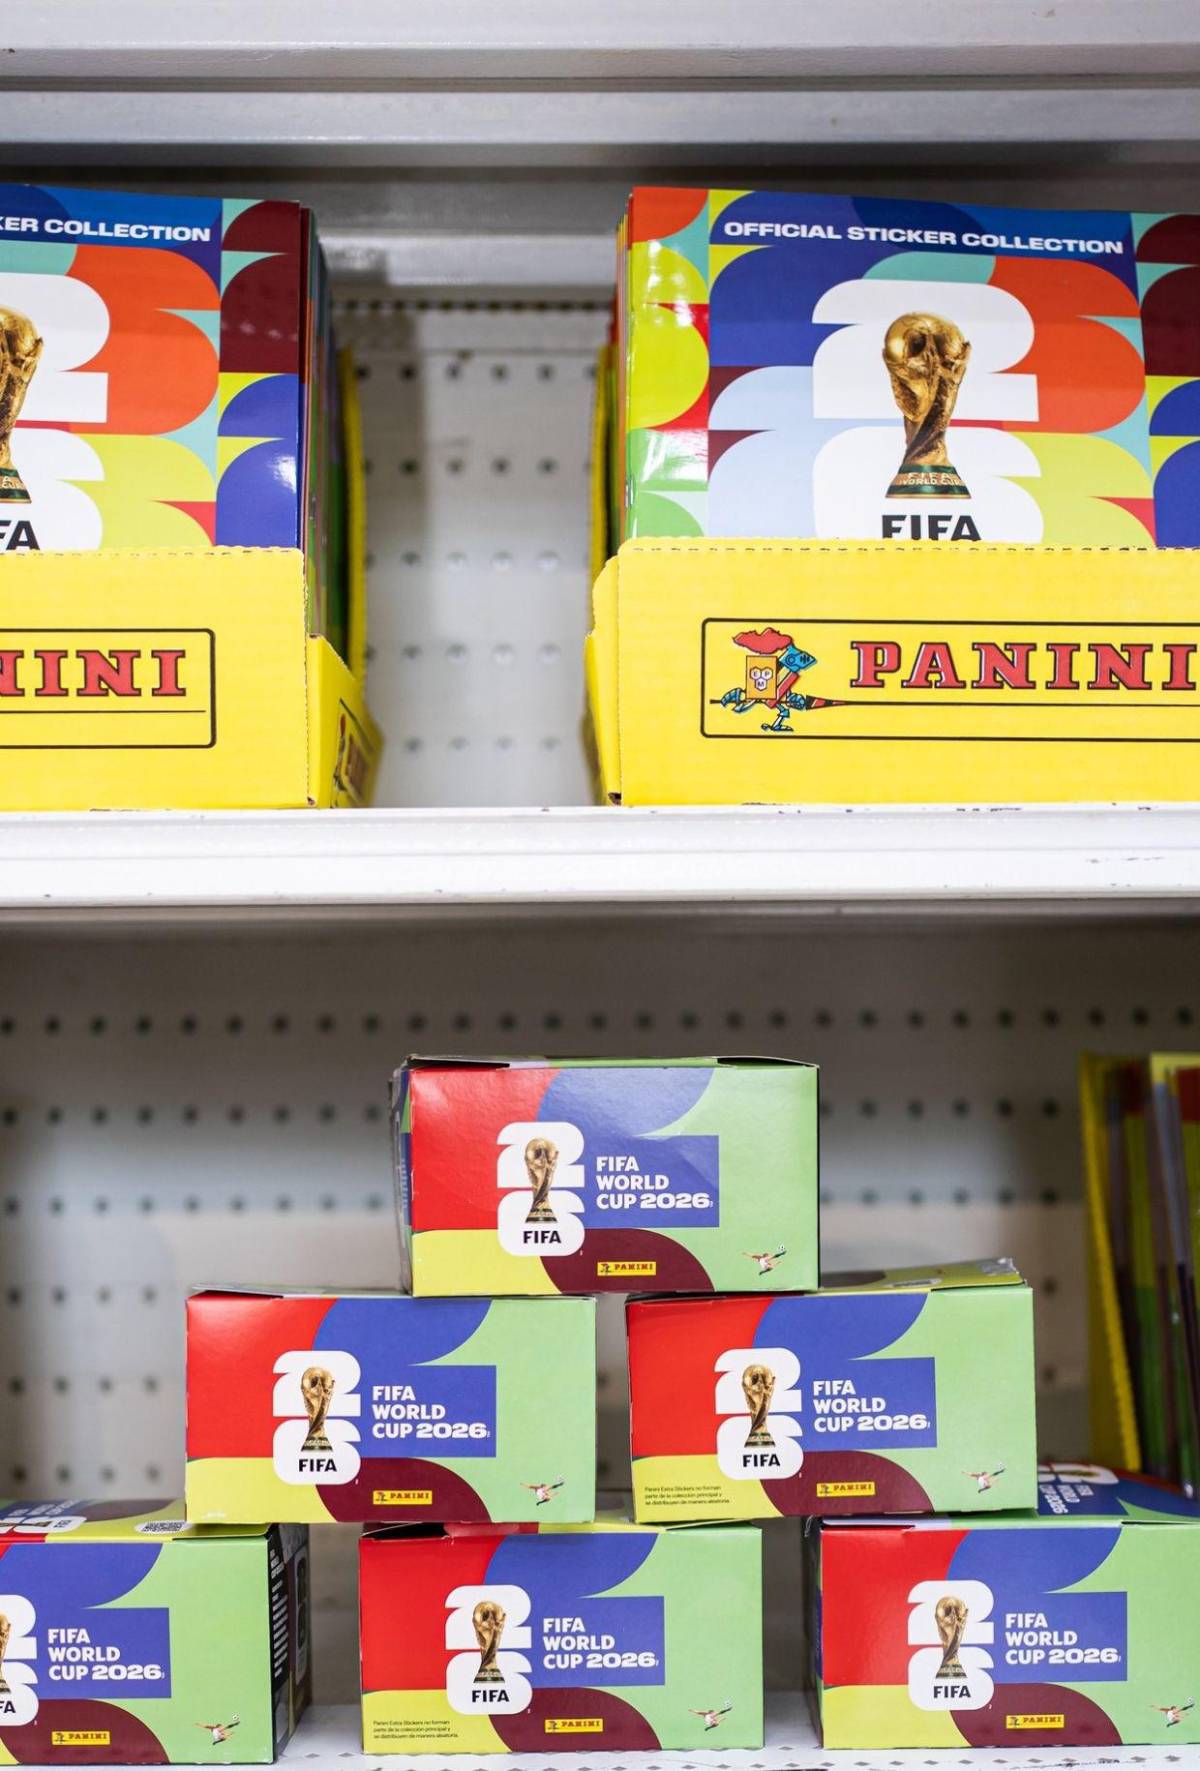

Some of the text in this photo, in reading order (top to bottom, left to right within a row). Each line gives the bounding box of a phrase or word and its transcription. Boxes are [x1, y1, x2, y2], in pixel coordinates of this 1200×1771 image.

[44, 219, 211, 242] COLLECTION
[724, 222, 1123, 254] OFFICIAL STICKER COLLECTION
[882, 514, 982, 541] FIFA
[850, 641, 1197, 691] PANINI
[597, 1155, 640, 1172] FIFA
[596, 1174, 670, 1191] WORLD
[596, 1192, 710, 1210] CUP 2026
[523, 1230, 561, 1244] FIFA
[614, 1263, 653, 1271] PANINI
[372, 1385, 416, 1401] FIFA
[813, 1379, 856, 1396] FIFA
[372, 1403, 446, 1420] WORLD
[813, 1397, 887, 1414] WORLD
[372, 1422, 487, 1439] CUP 2026
[814, 1414, 927, 1433] CUP 2026
[298, 1458, 337, 1472] FIFA
[742, 1453, 781, 1468] FIFA
[833, 1483, 872, 1491] PANINI
[543, 1617, 586, 1633] FIFA
[1005, 1612, 1048, 1629] FIFA
[47, 1628, 91, 1644] FIFA
[543, 1634, 616, 1651] WORLD
[1005, 1630, 1078, 1647] WORLD
[47, 1646, 121, 1663] WORLD
[543, 1651, 656, 1670] CUP 2026
[1005, 1647, 1119, 1665] CUP 2026
[48, 1664, 162, 1681] CUP 2026
[471, 1689, 510, 1703] FIFA
[933, 1685, 971, 1698] FIFA
[561, 1720, 600, 1728] PANINI
[1023, 1716, 1062, 1724] PANINI
